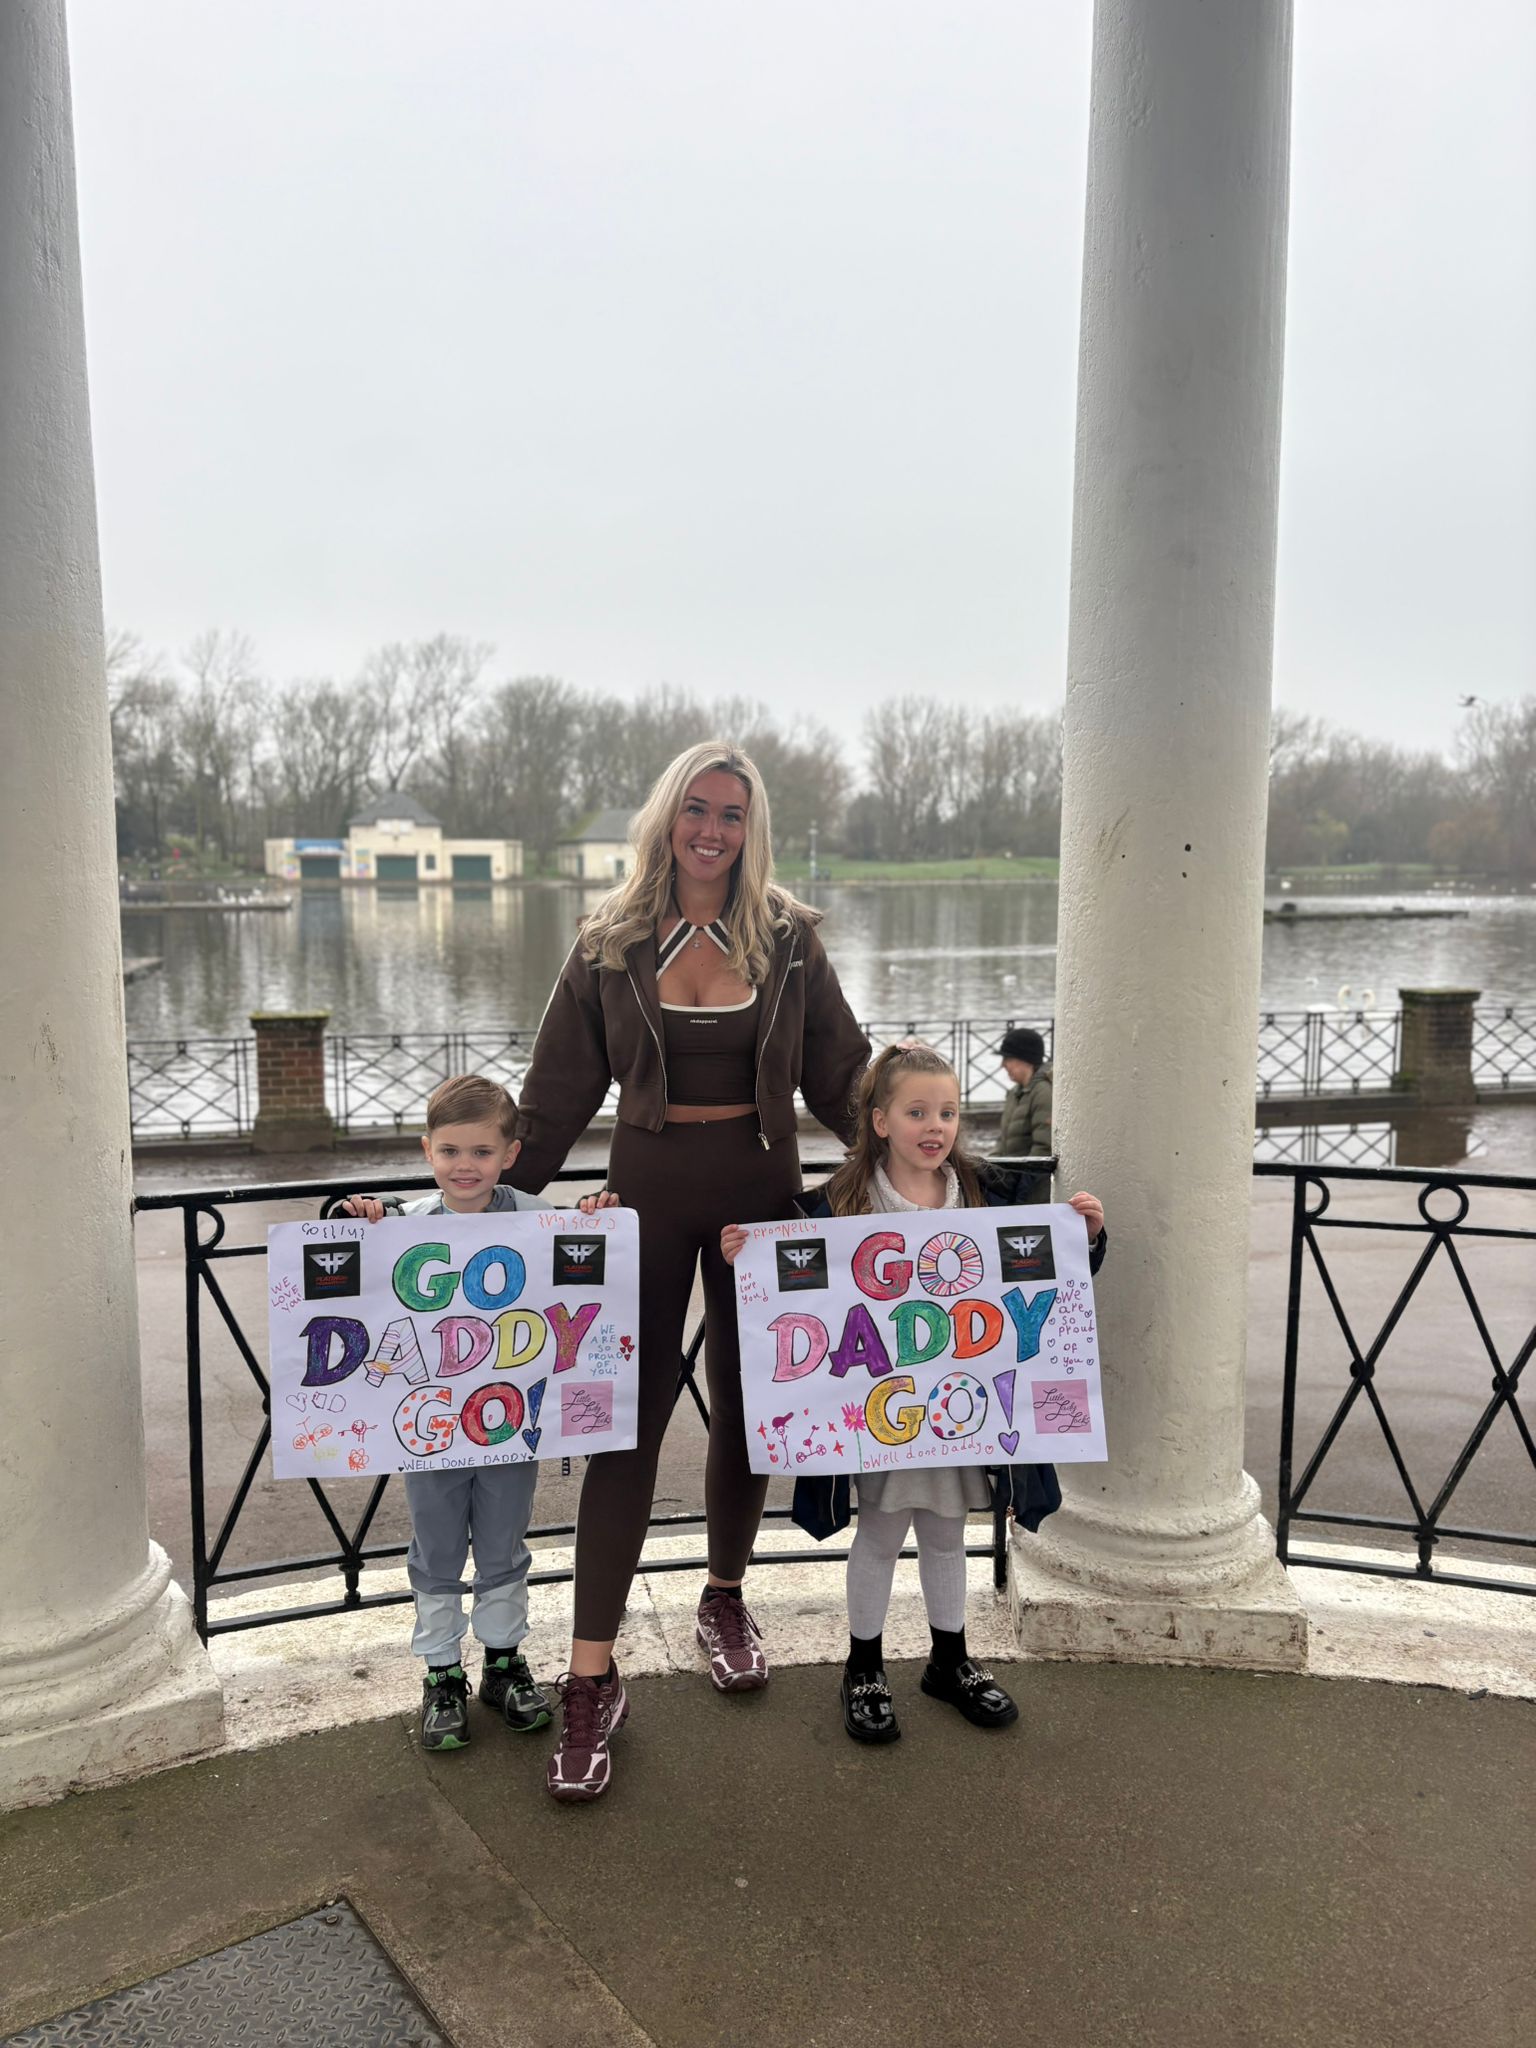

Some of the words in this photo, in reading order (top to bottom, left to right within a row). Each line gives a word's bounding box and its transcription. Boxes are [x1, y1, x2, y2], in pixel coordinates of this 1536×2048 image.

[851, 1231, 985, 1301] GO
[392, 1242, 527, 1313] GO
[271, 1284, 298, 1307] LOVE
[1060, 1288, 1081, 1303] We
[1058, 1303, 1085, 1314] are
[600, 1323, 616, 1336] WE
[766, 1286, 1058, 1382] DADDY
[1058, 1320, 1095, 1337] proud
[299, 1301, 601, 1388] DADDY
[590, 1334, 617, 1345] ARE
[587, 1351, 623, 1361] PROUD
[1063, 1343, 1078, 1354] of
[596, 1360, 611, 1369] OF
[1062, 1356, 1084, 1367] you
[870, 1452, 899, 1468] Well
[906, 1444, 937, 1459] done
[941, 1434, 982, 1456] Daddy
[402, 1459, 436, 1471] WELL
[441, 1456, 476, 1468] DONE
[484, 1452, 528, 1465] DADDY
